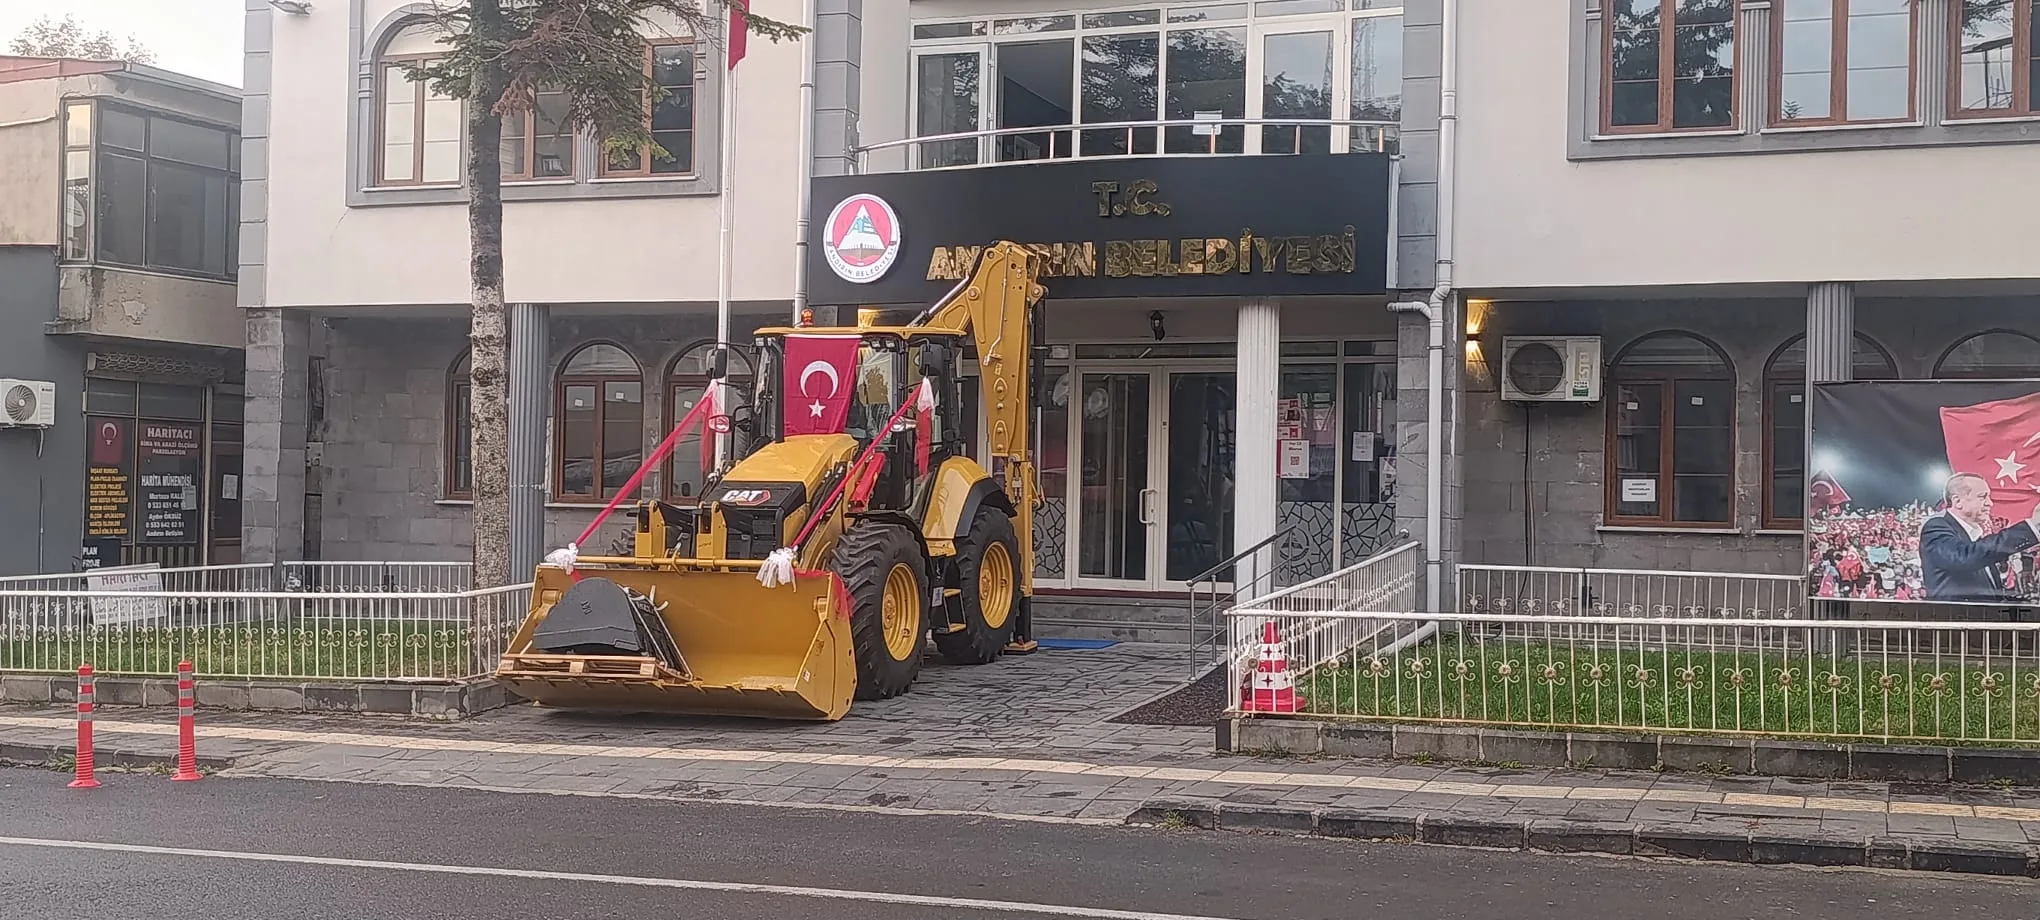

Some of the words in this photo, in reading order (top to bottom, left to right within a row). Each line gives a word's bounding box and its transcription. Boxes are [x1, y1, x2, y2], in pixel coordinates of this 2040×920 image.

[1091, 179, 1172, 217] T.C.
[926, 241, 1096, 281] ANRIN
[1104, 224, 1356, 278] BELEDİYESİ
[147, 426, 193, 440] HARİTACI
[141, 473, 162, 487] HARİTA
[162, 473, 192, 487] MÜHENDİSİ
[719, 489, 765, 503] CAT
[82, 546, 98, 556] PLAN
